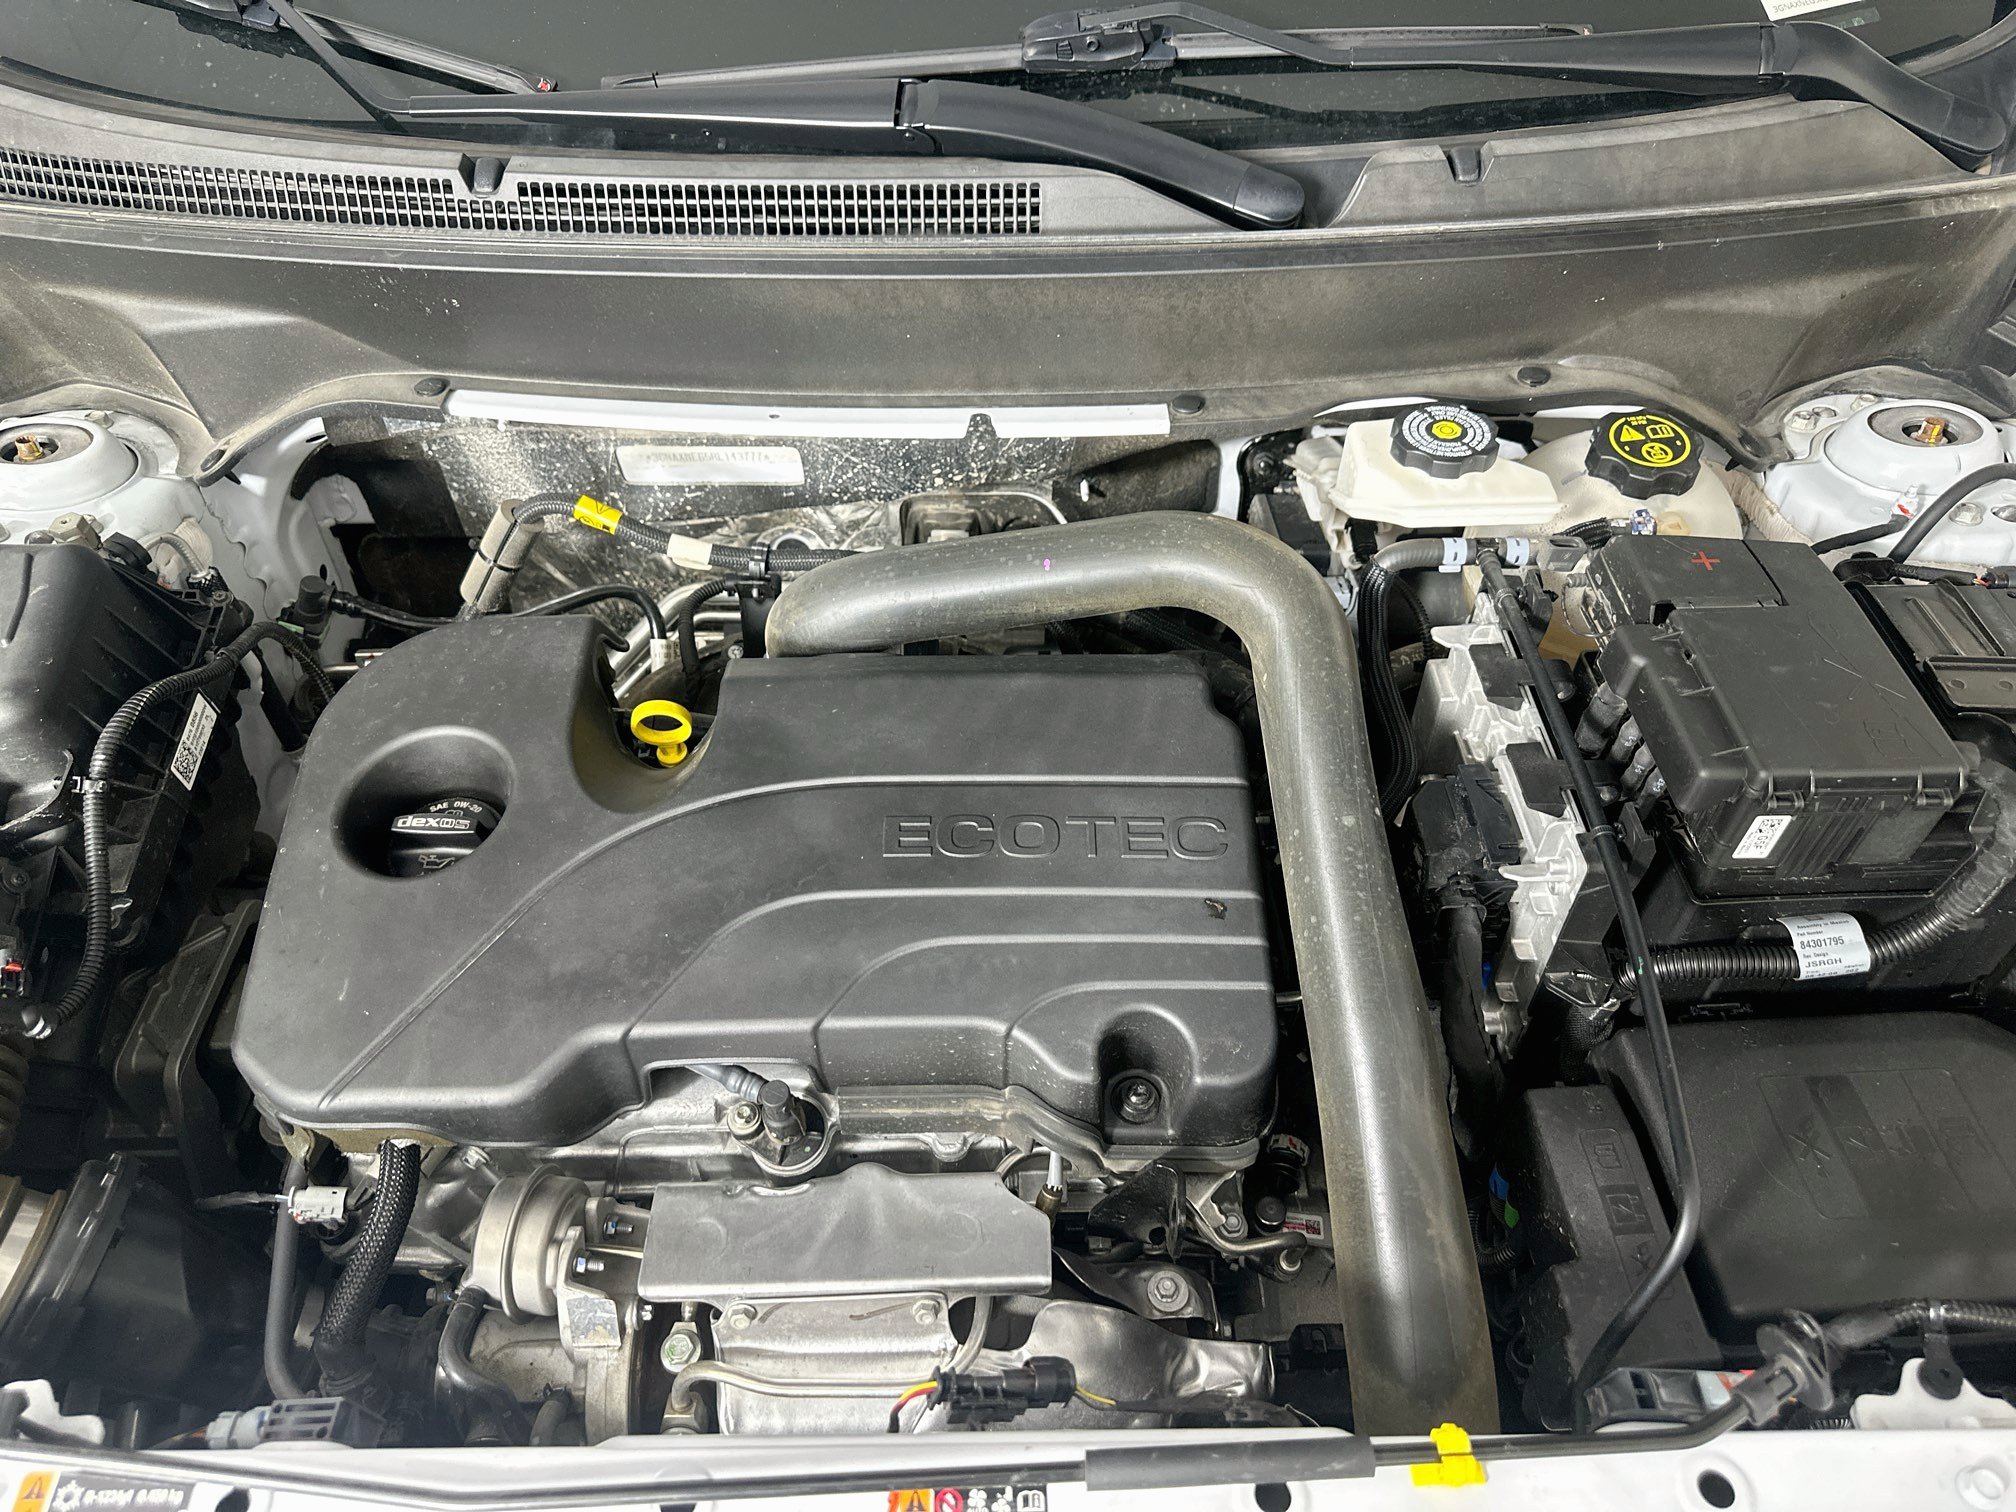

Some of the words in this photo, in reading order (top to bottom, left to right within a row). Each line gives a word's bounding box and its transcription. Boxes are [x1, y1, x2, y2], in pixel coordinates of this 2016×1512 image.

[1772, 0, 1829, 14] 3GNAXNEG
[429, 801, 449, 813] SAE
[453, 800, 483, 814] 0W-20
[397, 815, 471, 830] dexos
[882, 814, 1229, 860] ECOTEC
[1800, 936, 1845, 950] 84301795
